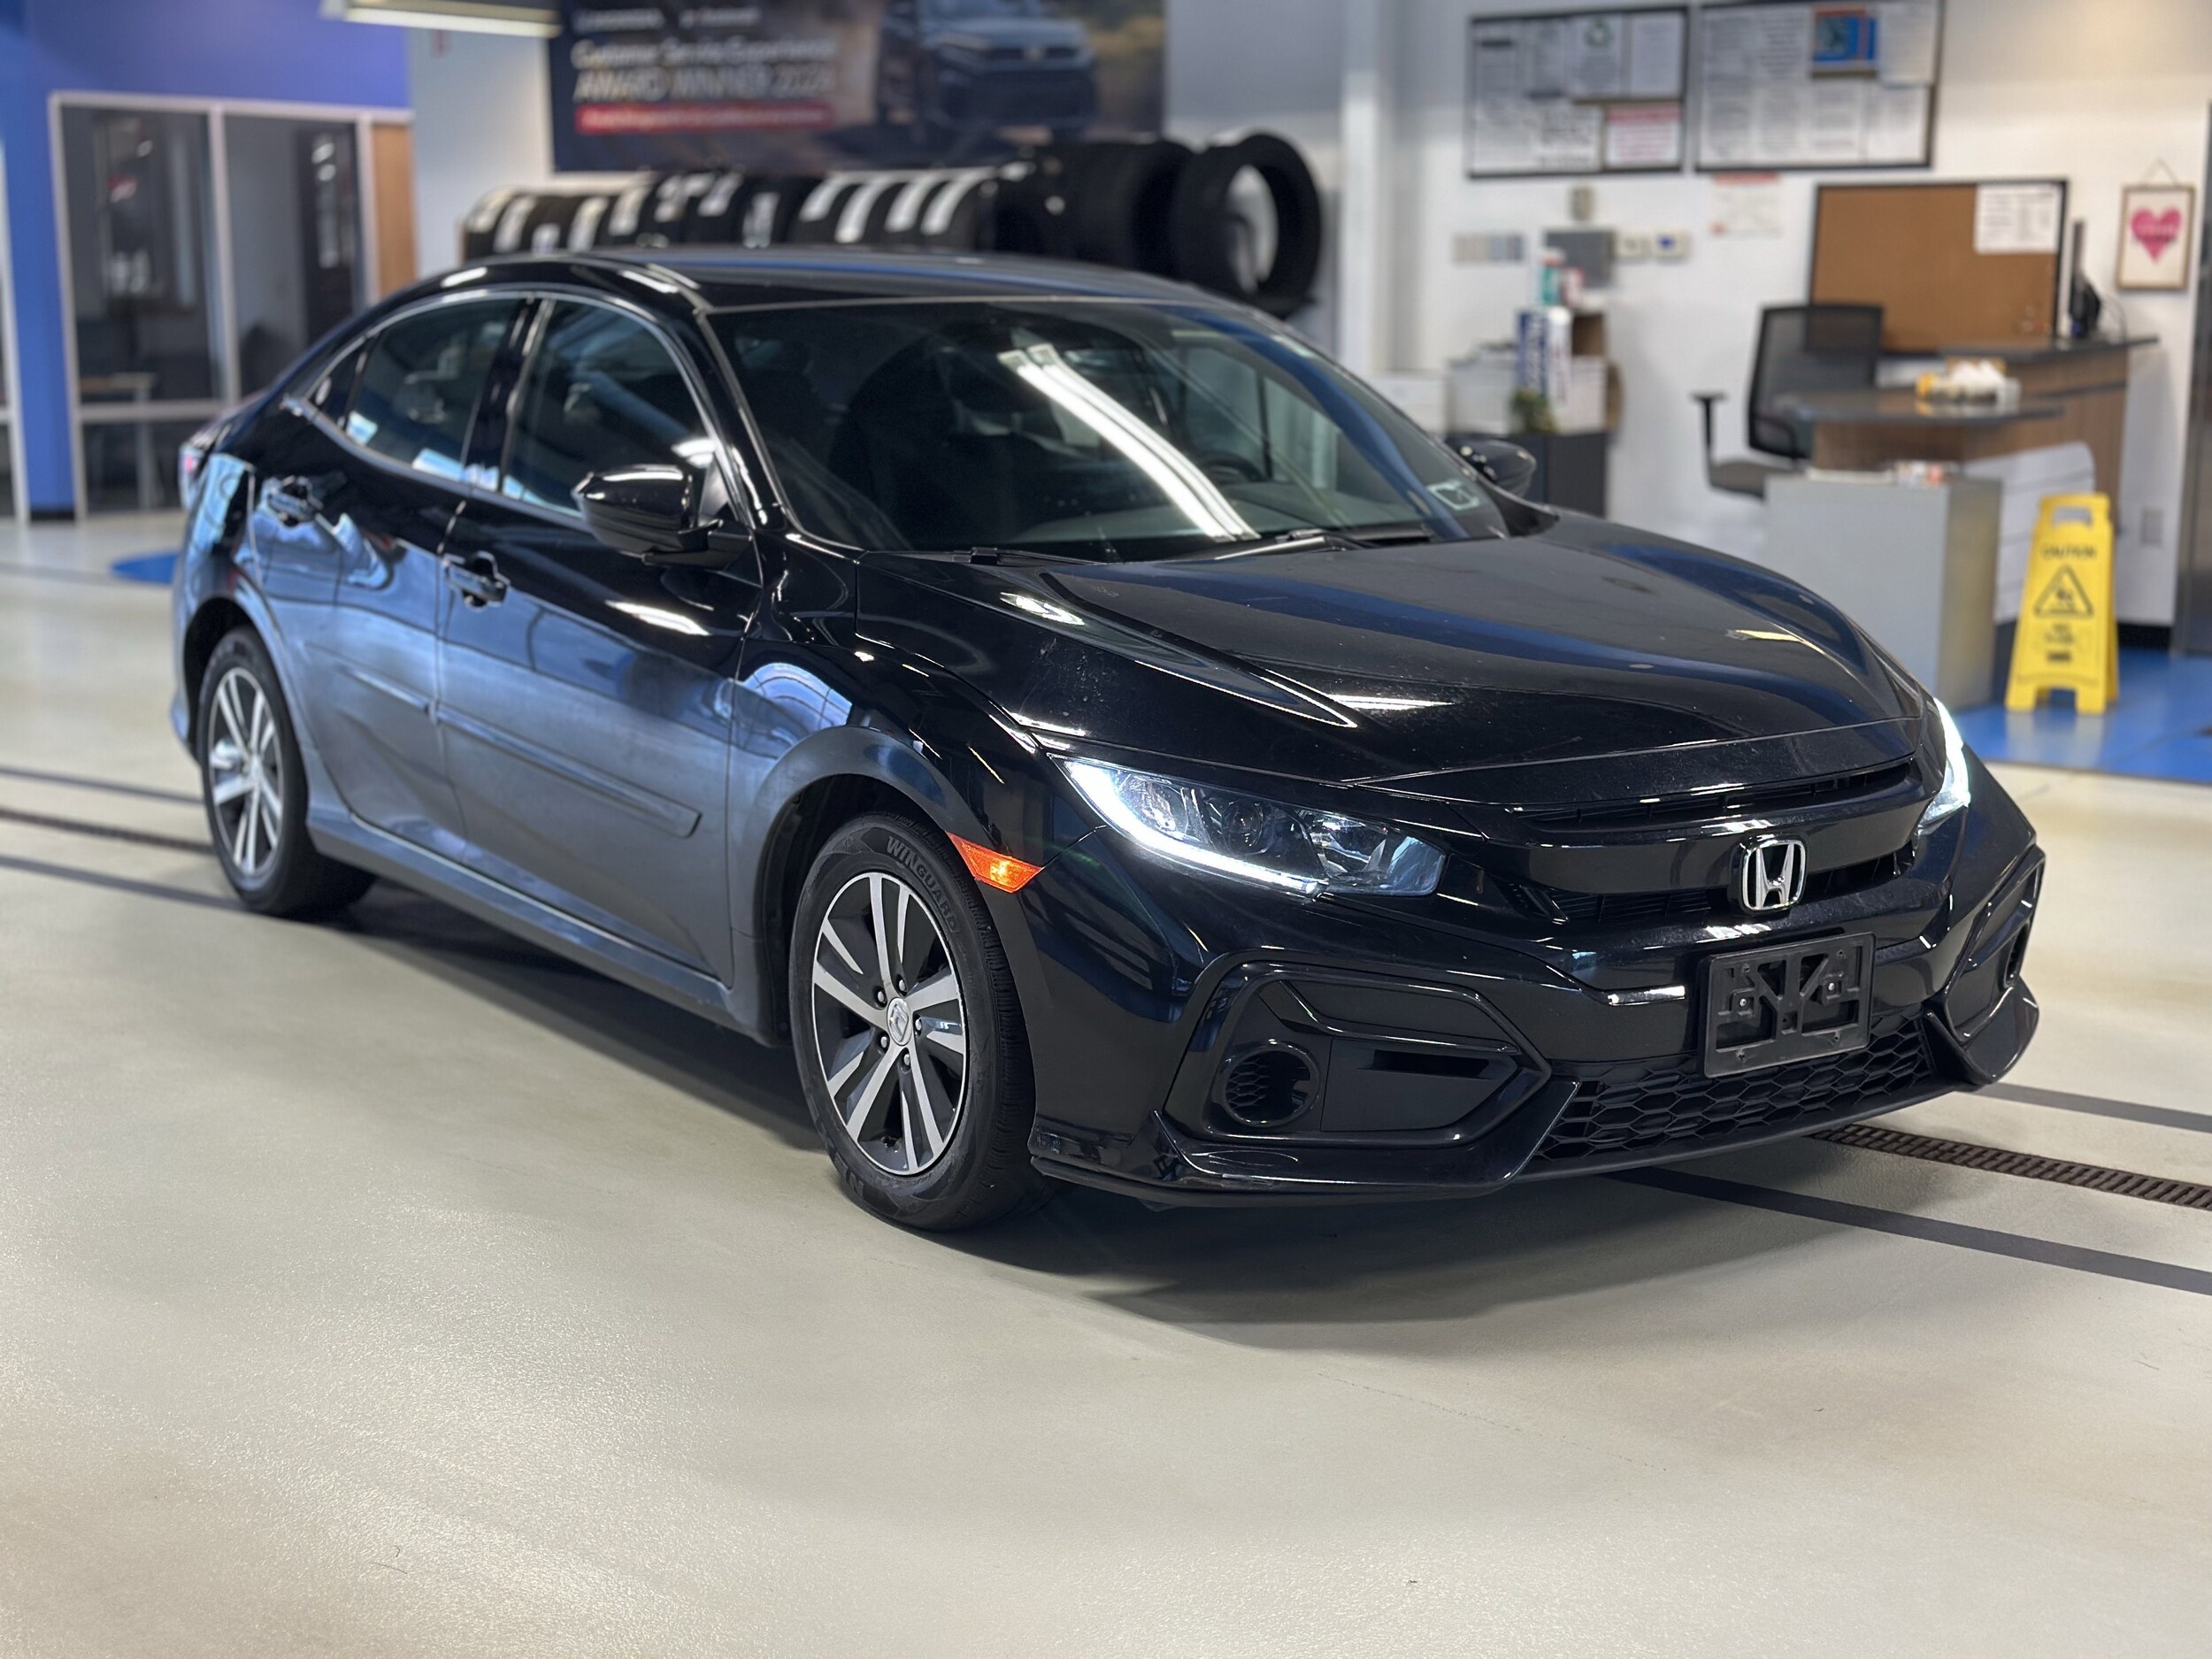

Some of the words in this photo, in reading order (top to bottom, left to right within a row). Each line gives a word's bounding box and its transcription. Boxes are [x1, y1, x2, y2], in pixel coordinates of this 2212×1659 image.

[572, 66, 670, 102] AWARD
[672, 65, 769, 100] WINNER
[887, 835, 957, 933] WINGUARD
